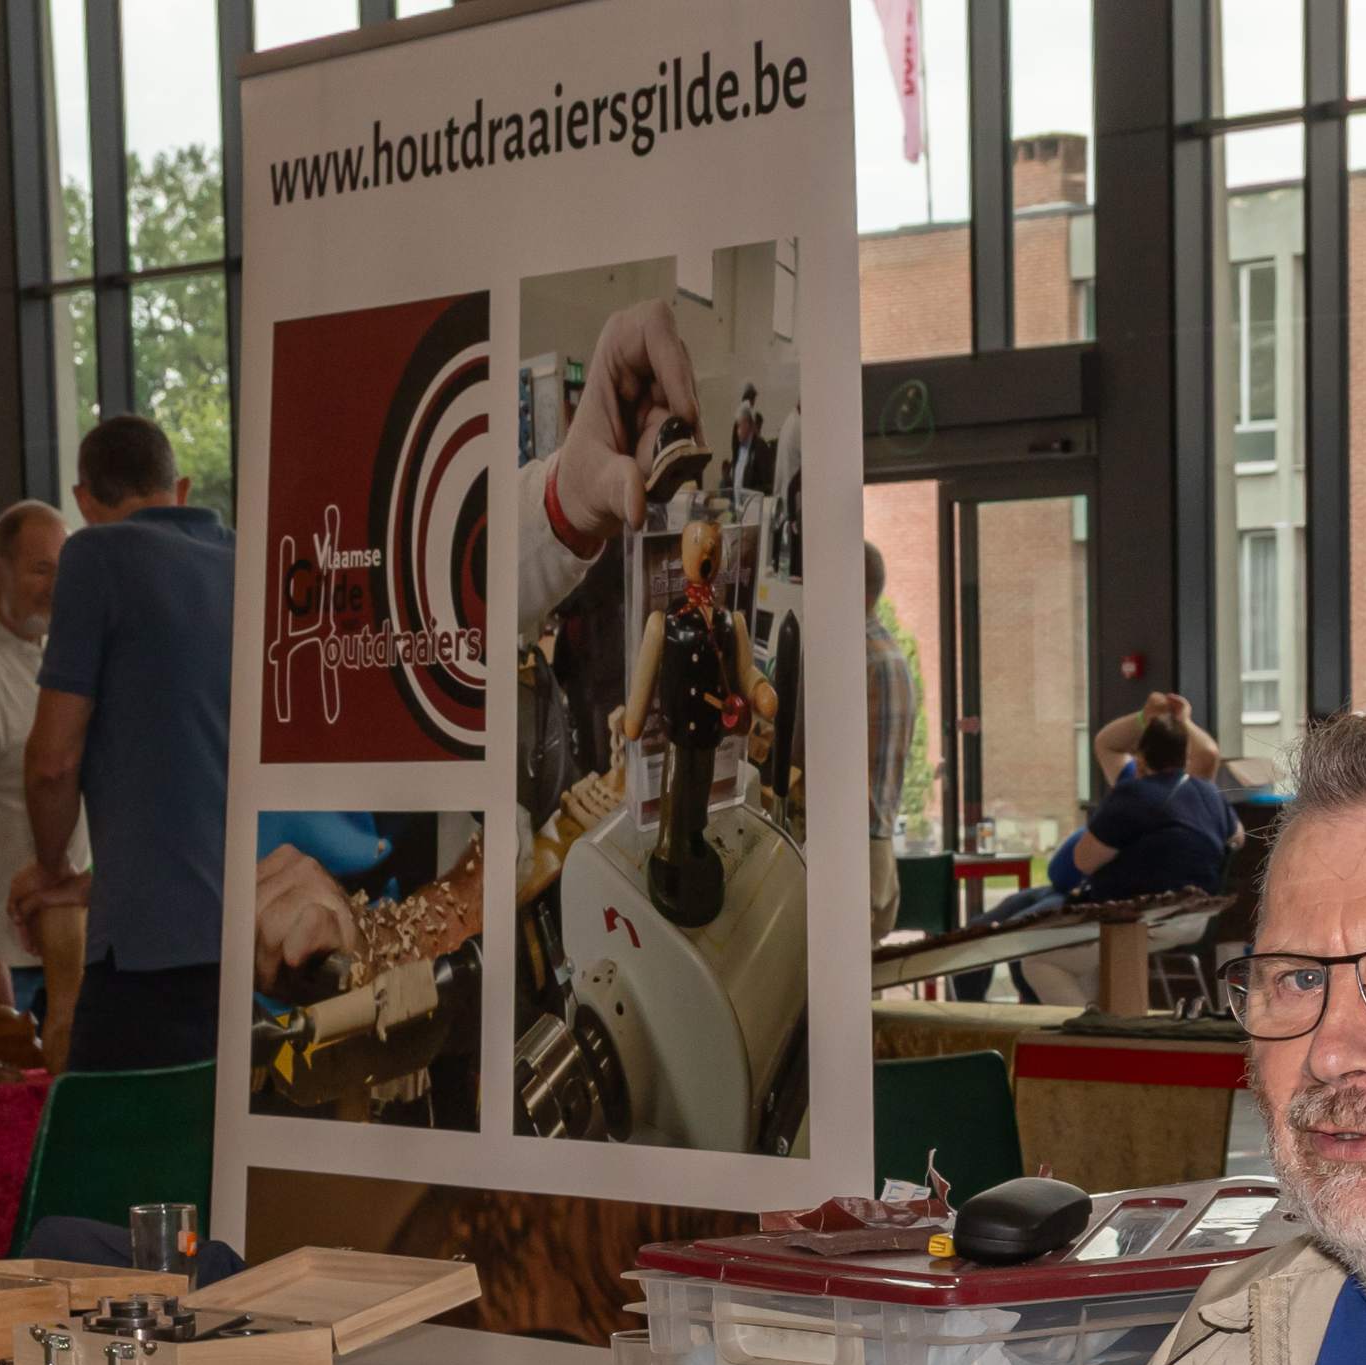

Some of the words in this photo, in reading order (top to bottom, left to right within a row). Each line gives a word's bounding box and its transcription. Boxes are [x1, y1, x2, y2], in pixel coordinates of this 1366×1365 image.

[270, 40, 808, 206] www.houtdraaiersgilde.be
[313, 532, 382, 569] Vlaamse
[284, 559, 363, 616] Gilde
